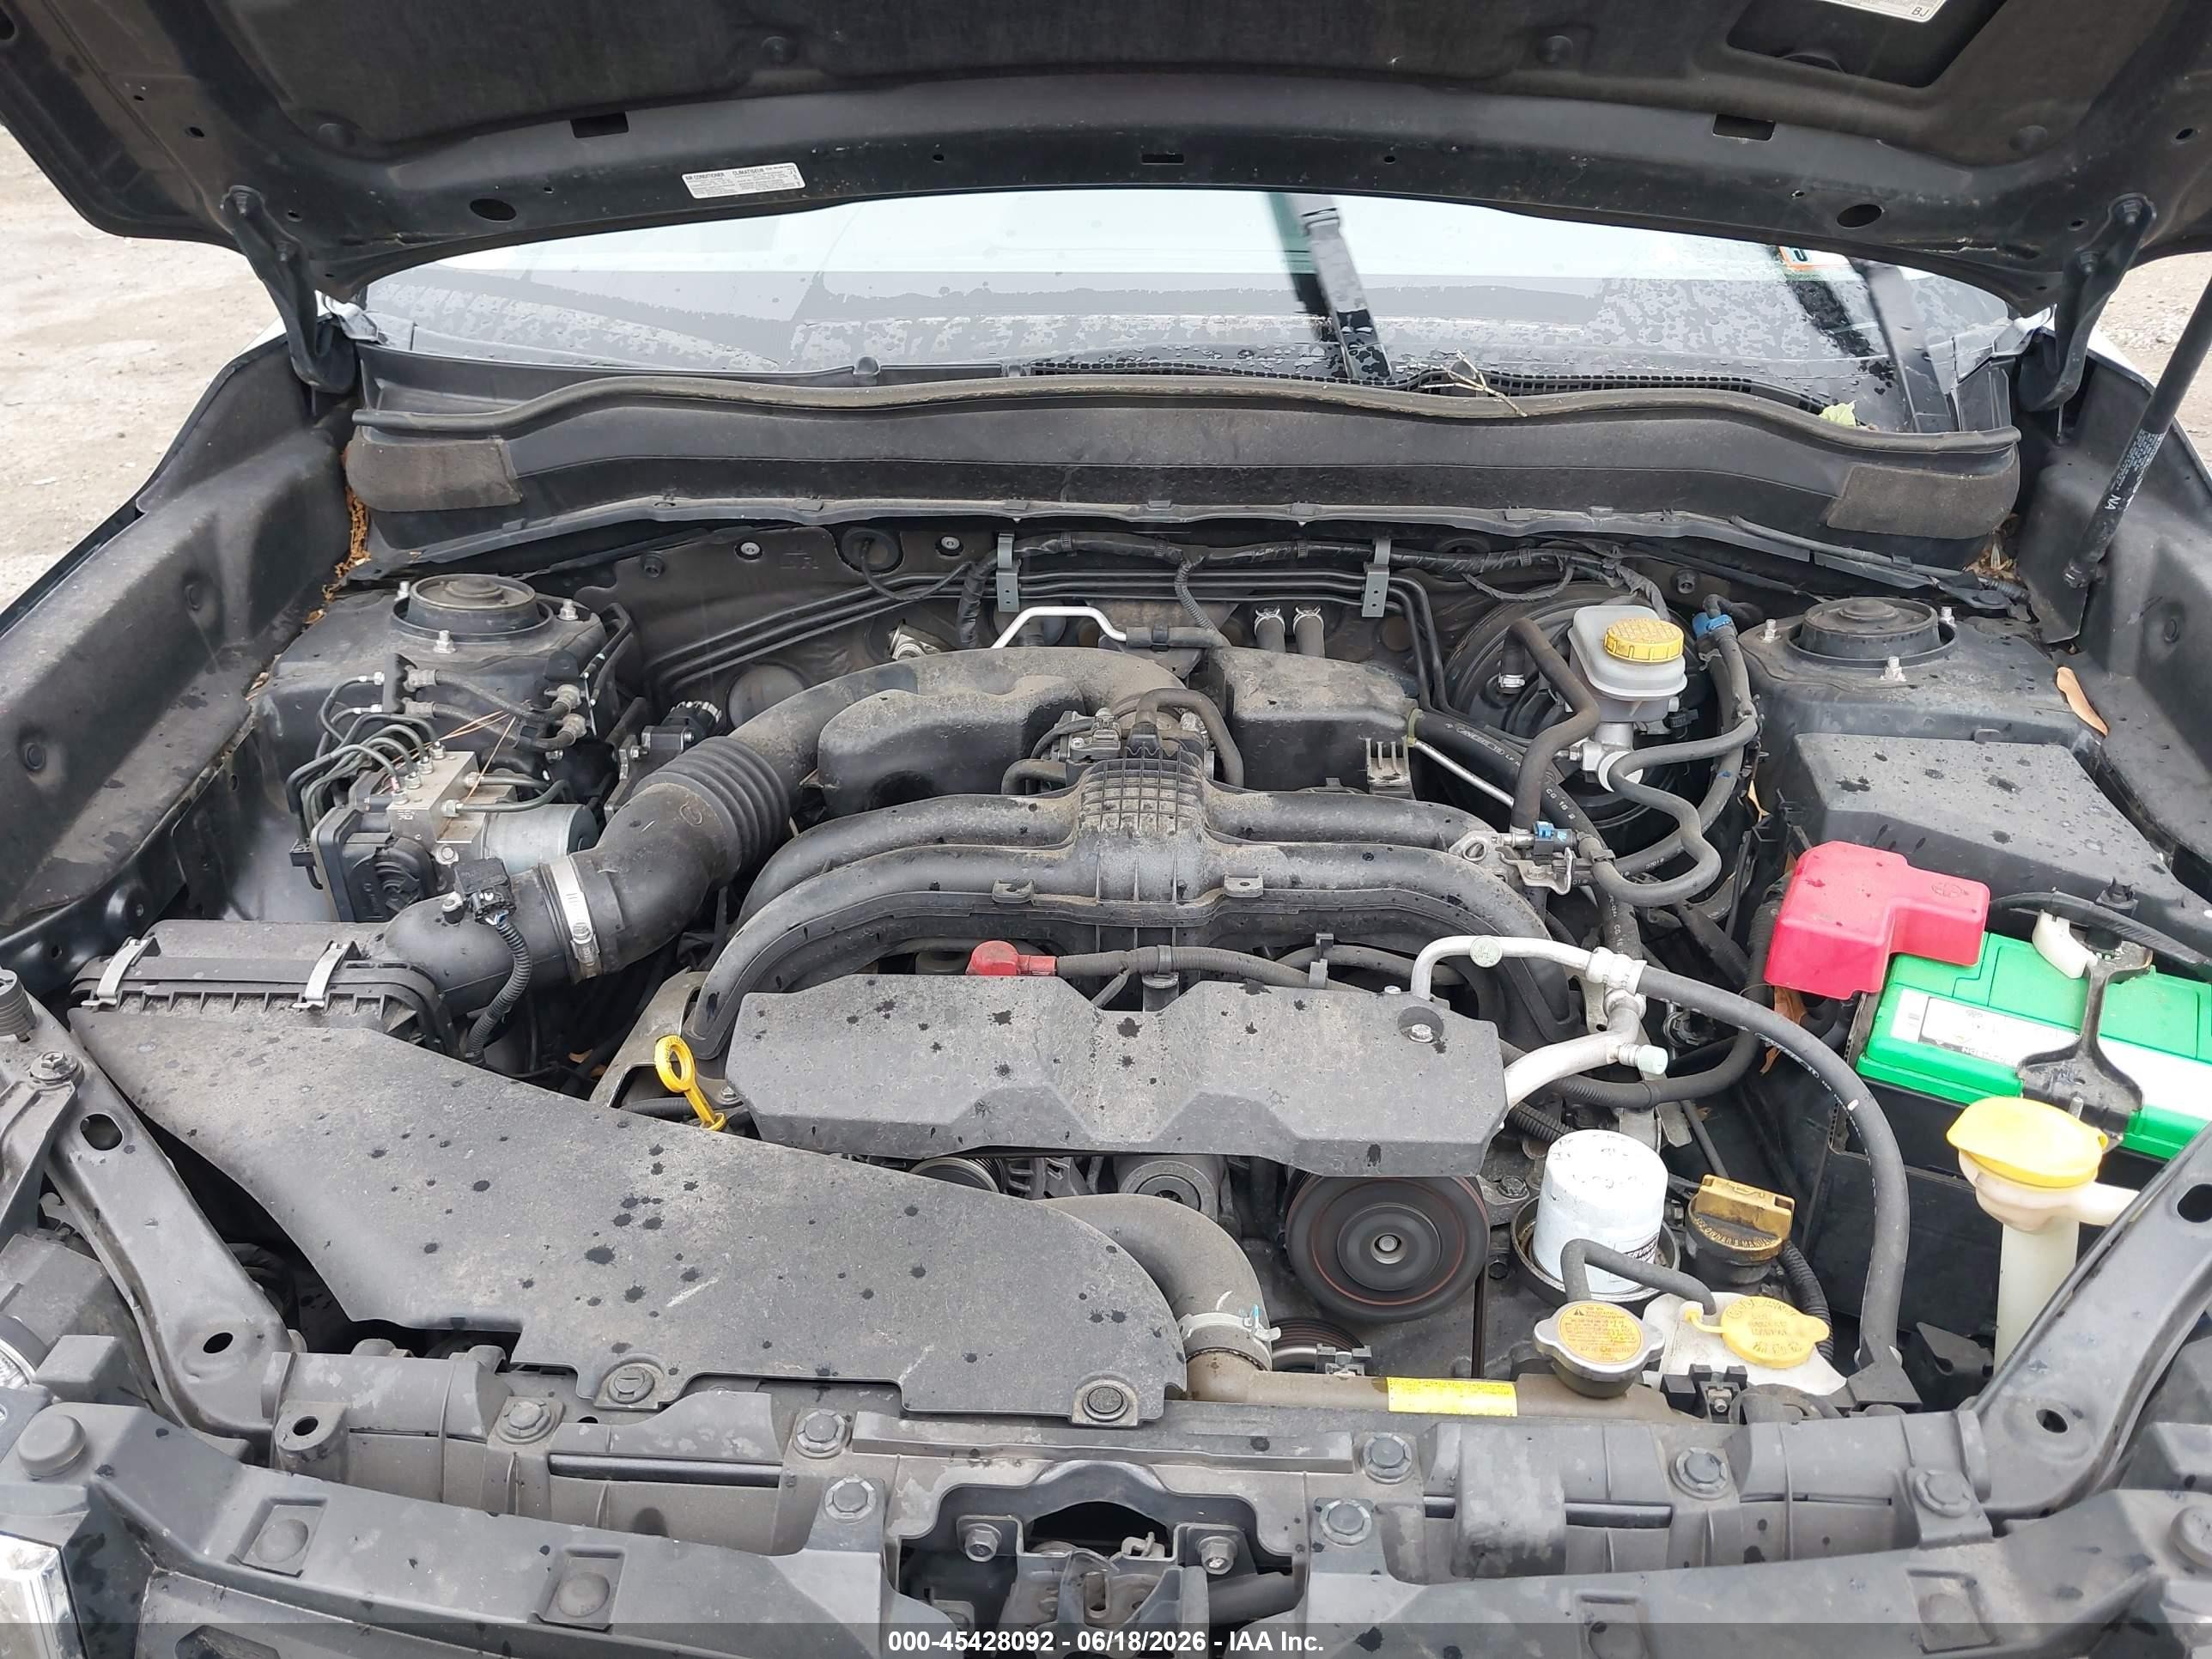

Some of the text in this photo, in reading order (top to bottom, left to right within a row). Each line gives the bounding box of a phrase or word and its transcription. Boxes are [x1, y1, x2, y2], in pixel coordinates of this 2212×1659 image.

[1911, 6, 1929, 17] BJ
[2104, 494, 2122, 510] NA
[1705, 1228, 1739, 1246] OWNER'S
[1741, 1237, 1773, 1248] MANUAL
